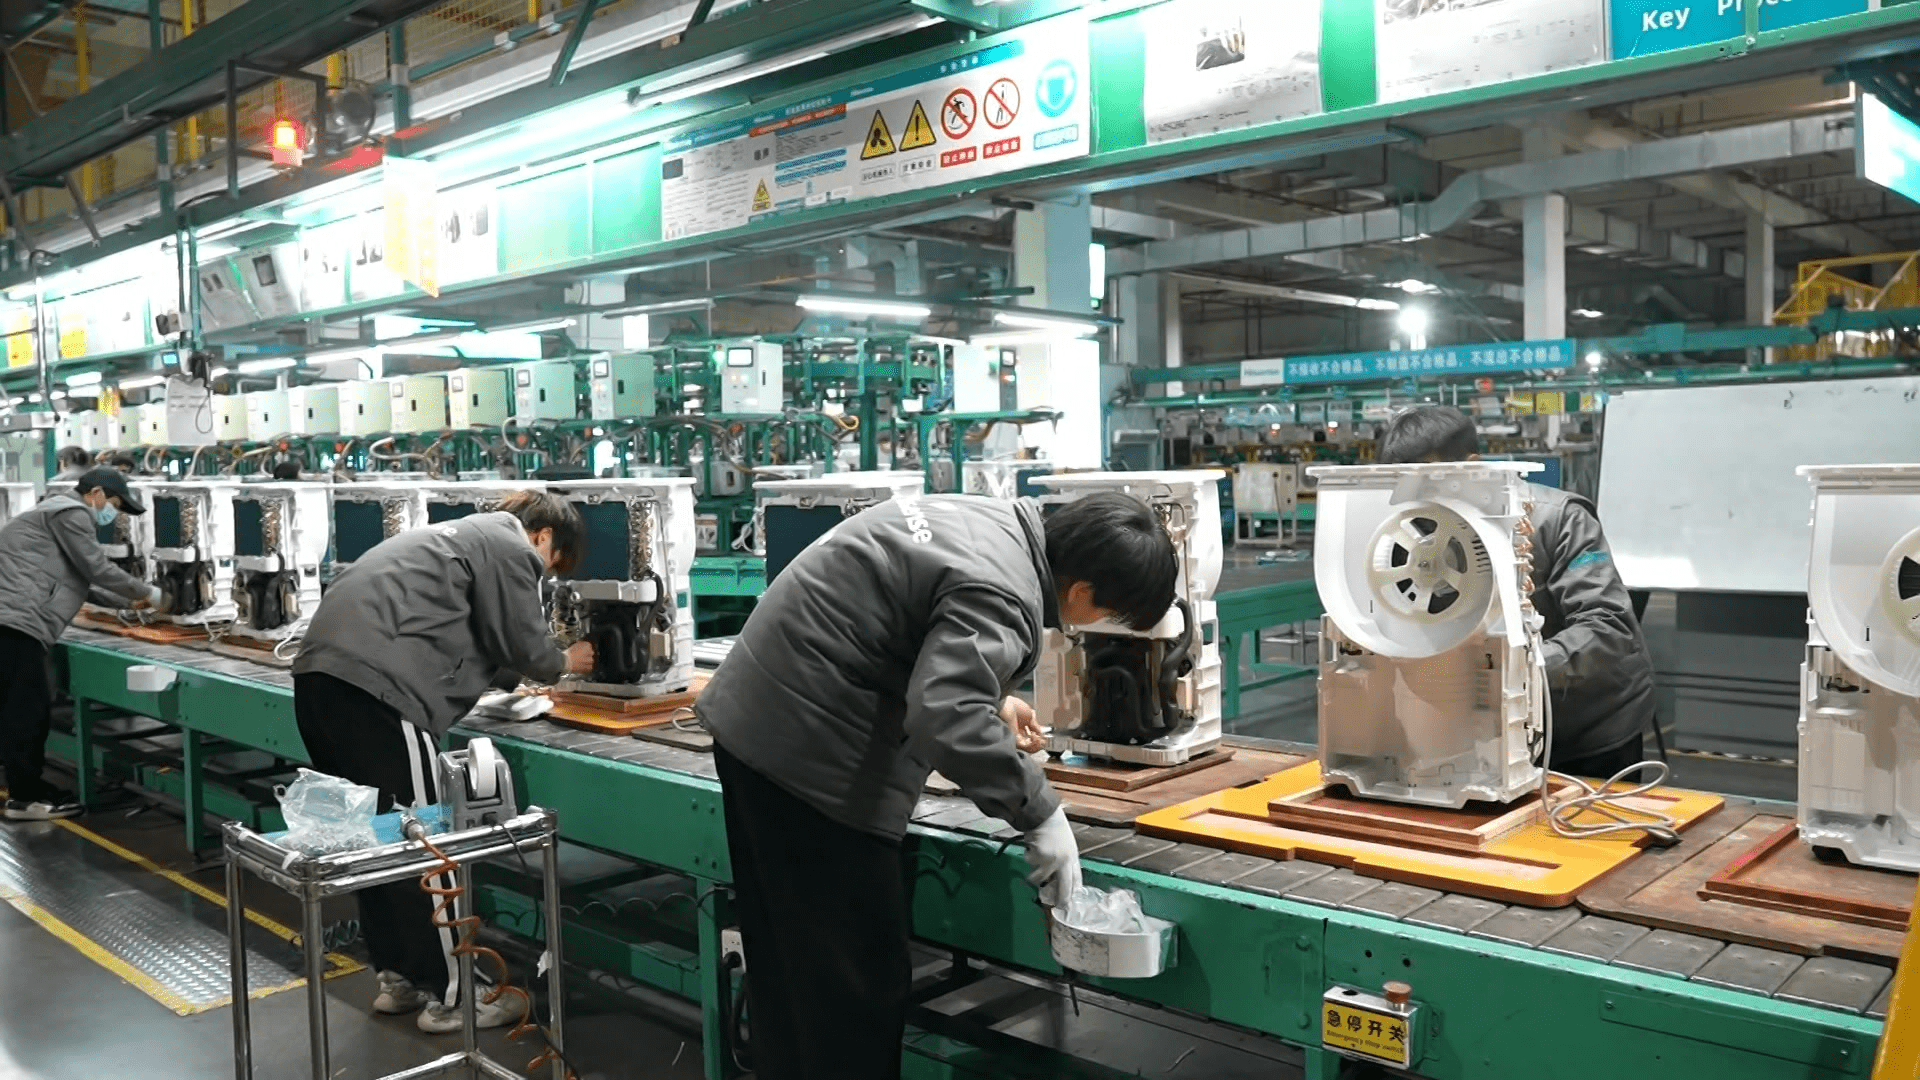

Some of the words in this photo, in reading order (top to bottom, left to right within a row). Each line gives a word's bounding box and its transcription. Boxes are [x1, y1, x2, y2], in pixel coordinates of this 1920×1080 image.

[1642, 7, 1691, 32] Key
[1326, 1009, 1405, 1046] 急停开关
